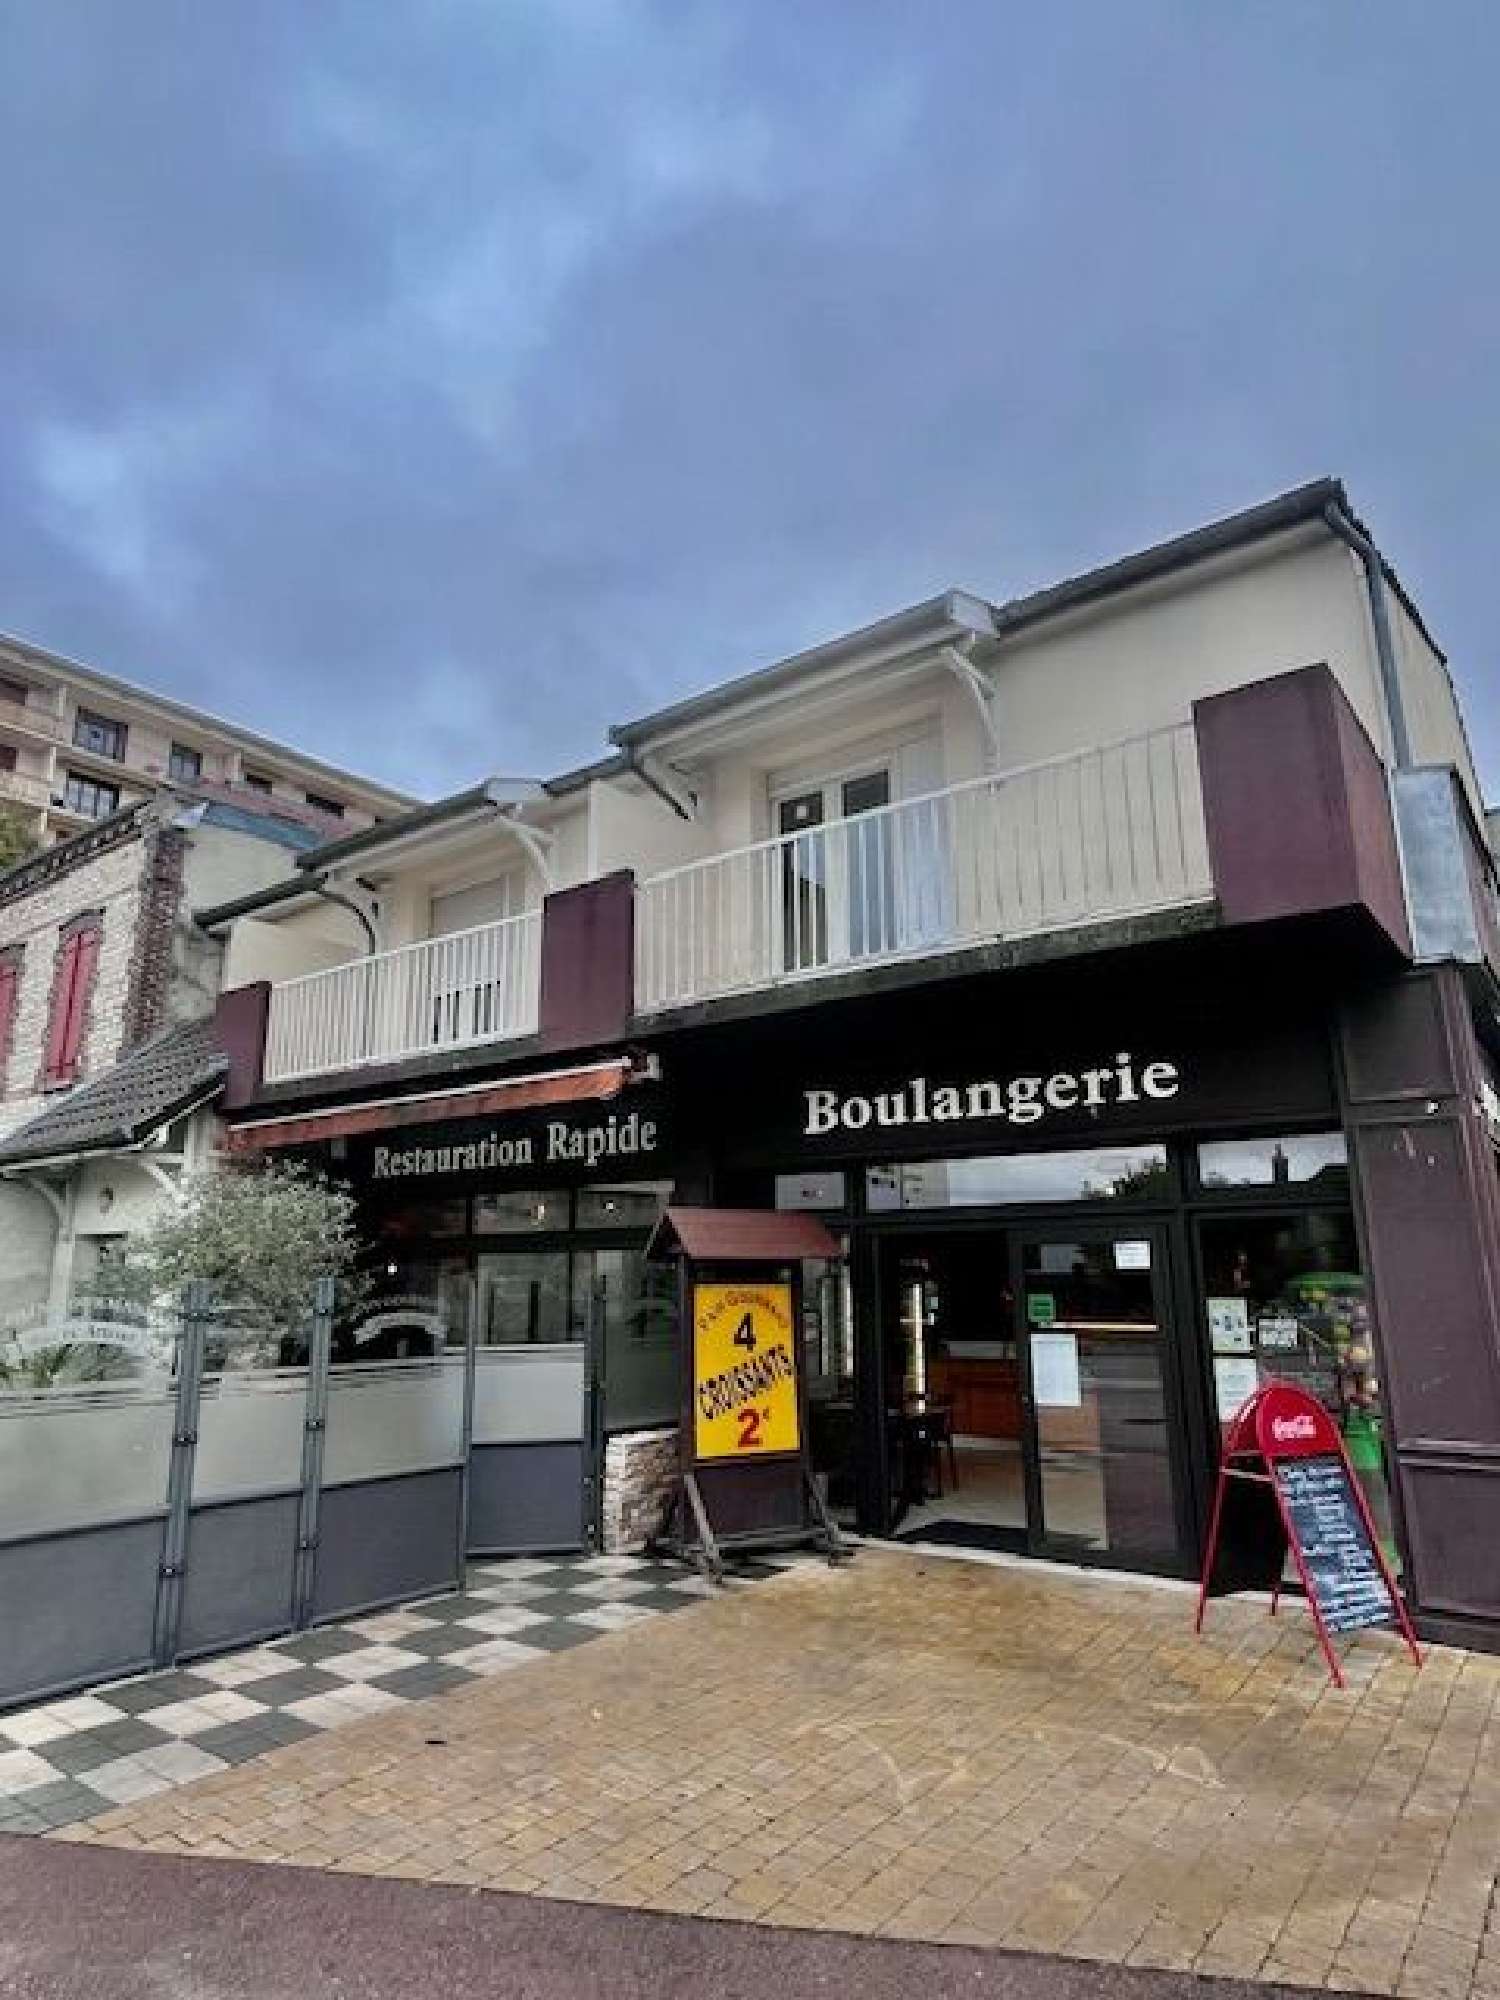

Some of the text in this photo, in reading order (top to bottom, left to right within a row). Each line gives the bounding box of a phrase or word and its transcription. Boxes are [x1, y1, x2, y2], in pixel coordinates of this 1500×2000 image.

[803, 1052, 1179, 1135] Boulangerie
[371, 1112, 657, 1178] Restauration Rapide
[734, 1313, 757, 1352] 4
